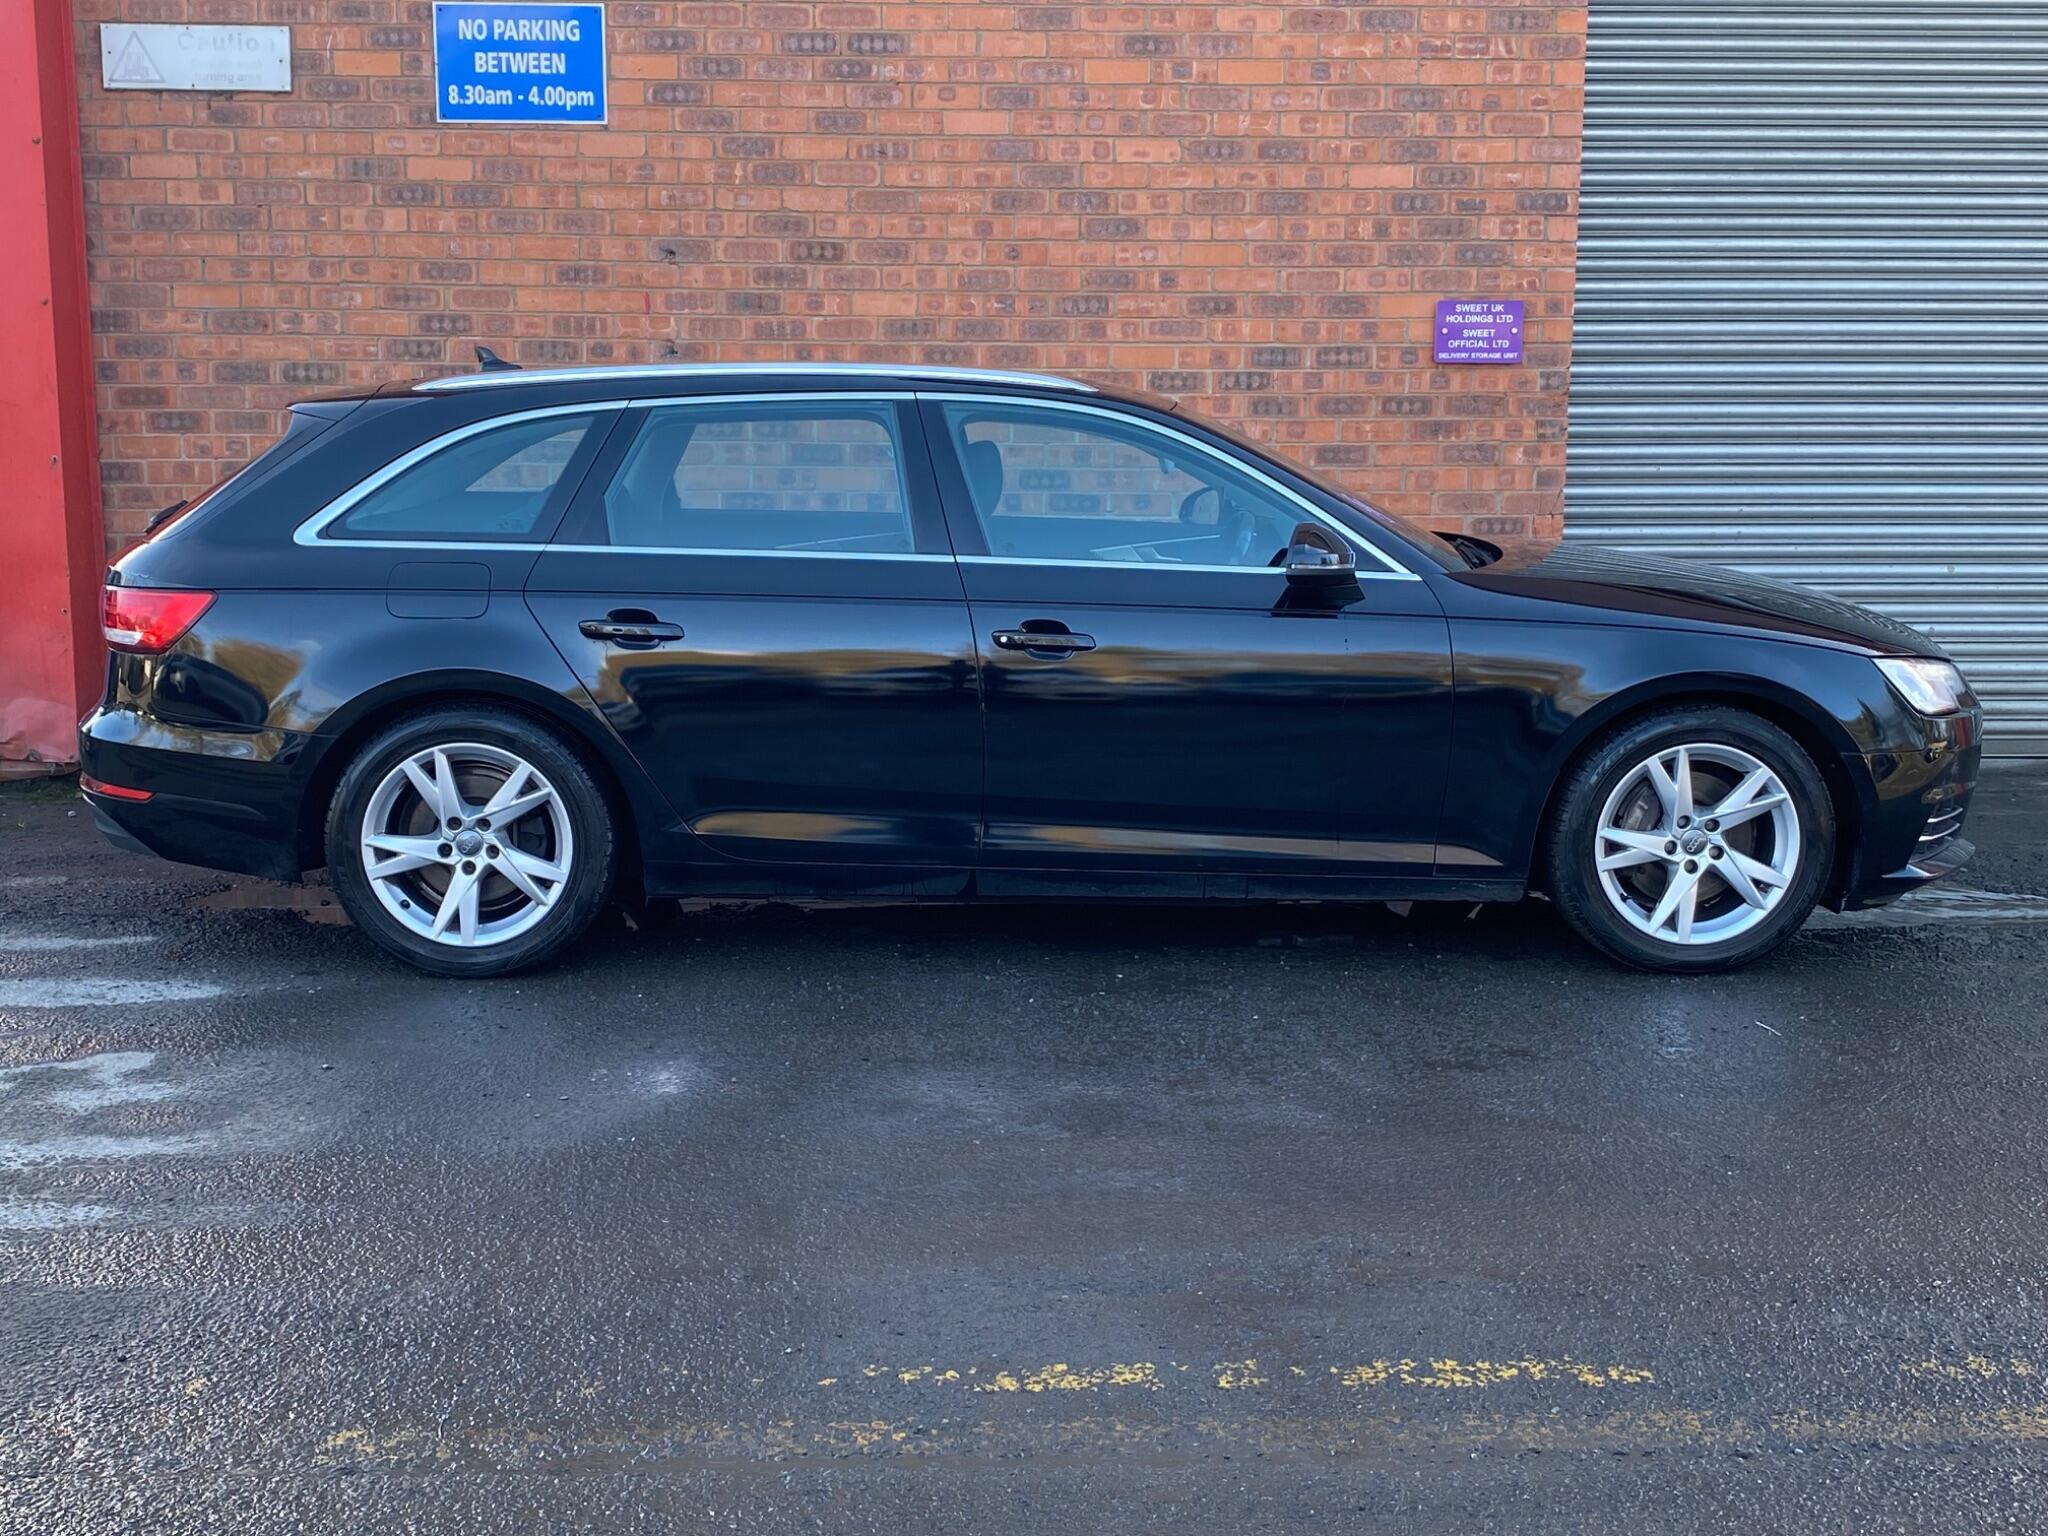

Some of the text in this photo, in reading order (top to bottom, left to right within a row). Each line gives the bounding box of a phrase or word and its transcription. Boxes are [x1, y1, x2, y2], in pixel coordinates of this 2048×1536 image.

[458, 19, 581, 42] NO PARKING
[177, 31, 275, 53] Caution
[474, 52, 566, 74] BETWEEN
[448, 84, 513, 105] 8.30am
[528, 86, 595, 111] 4.00pm
[1455, 304, 1504, 312] SWEET UK
[1446, 315, 1513, 323] HOLDINGS LTD
[1462, 329, 1496, 337] SWEET
[1448, 340, 1509, 348] OFFICIAL LTD
